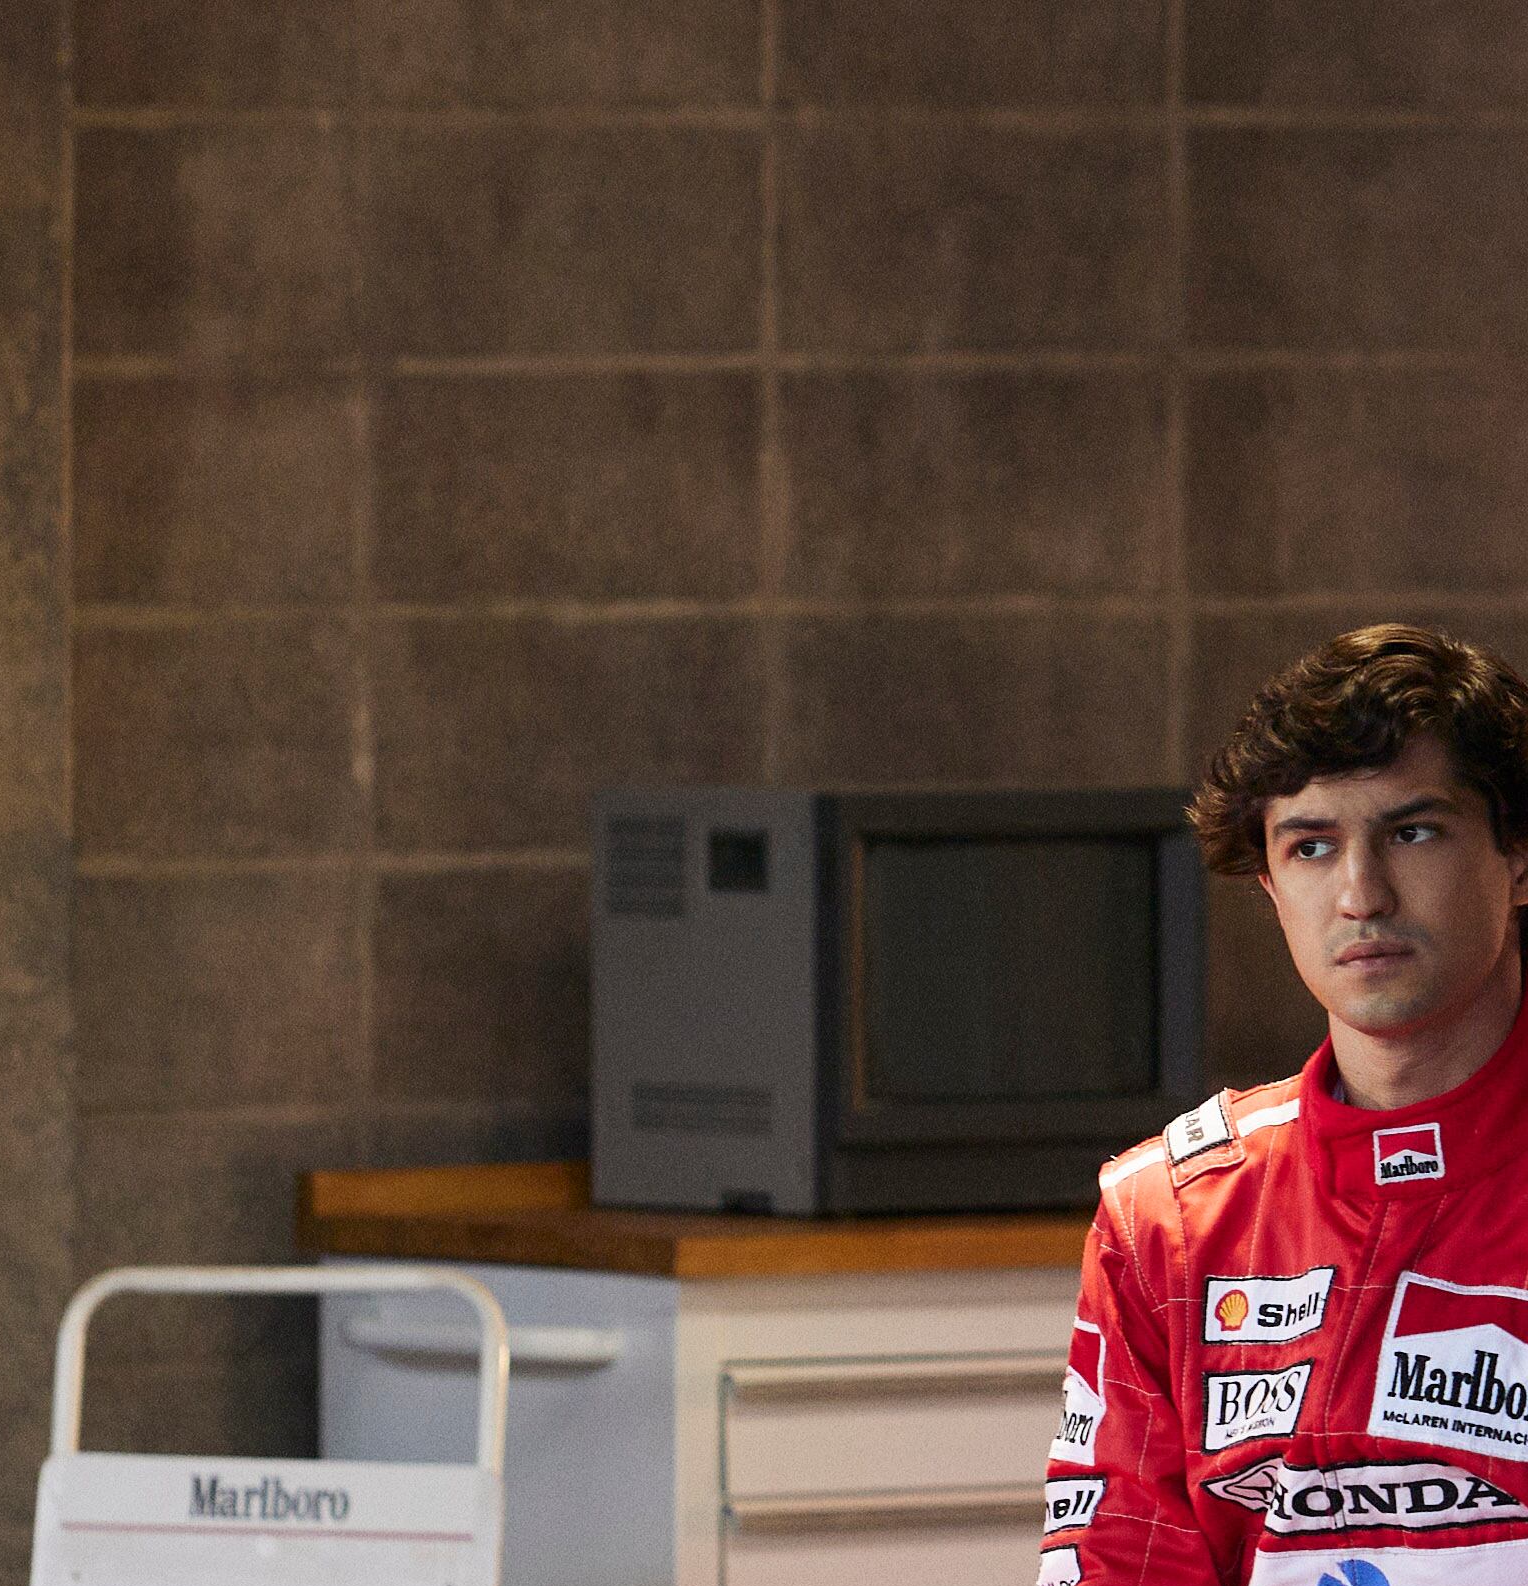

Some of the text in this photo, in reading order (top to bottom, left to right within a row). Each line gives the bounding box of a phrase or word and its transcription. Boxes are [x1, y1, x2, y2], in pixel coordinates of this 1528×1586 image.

[1380, 1155, 1439, 1178] Marlboro
[1257, 1292, 1320, 1328] Shell
[1215, 1371, 1301, 1426] BOSS
[188, 1474, 351, 1521] Marlboro
[1047, 1490, 1096, 1520] ell
